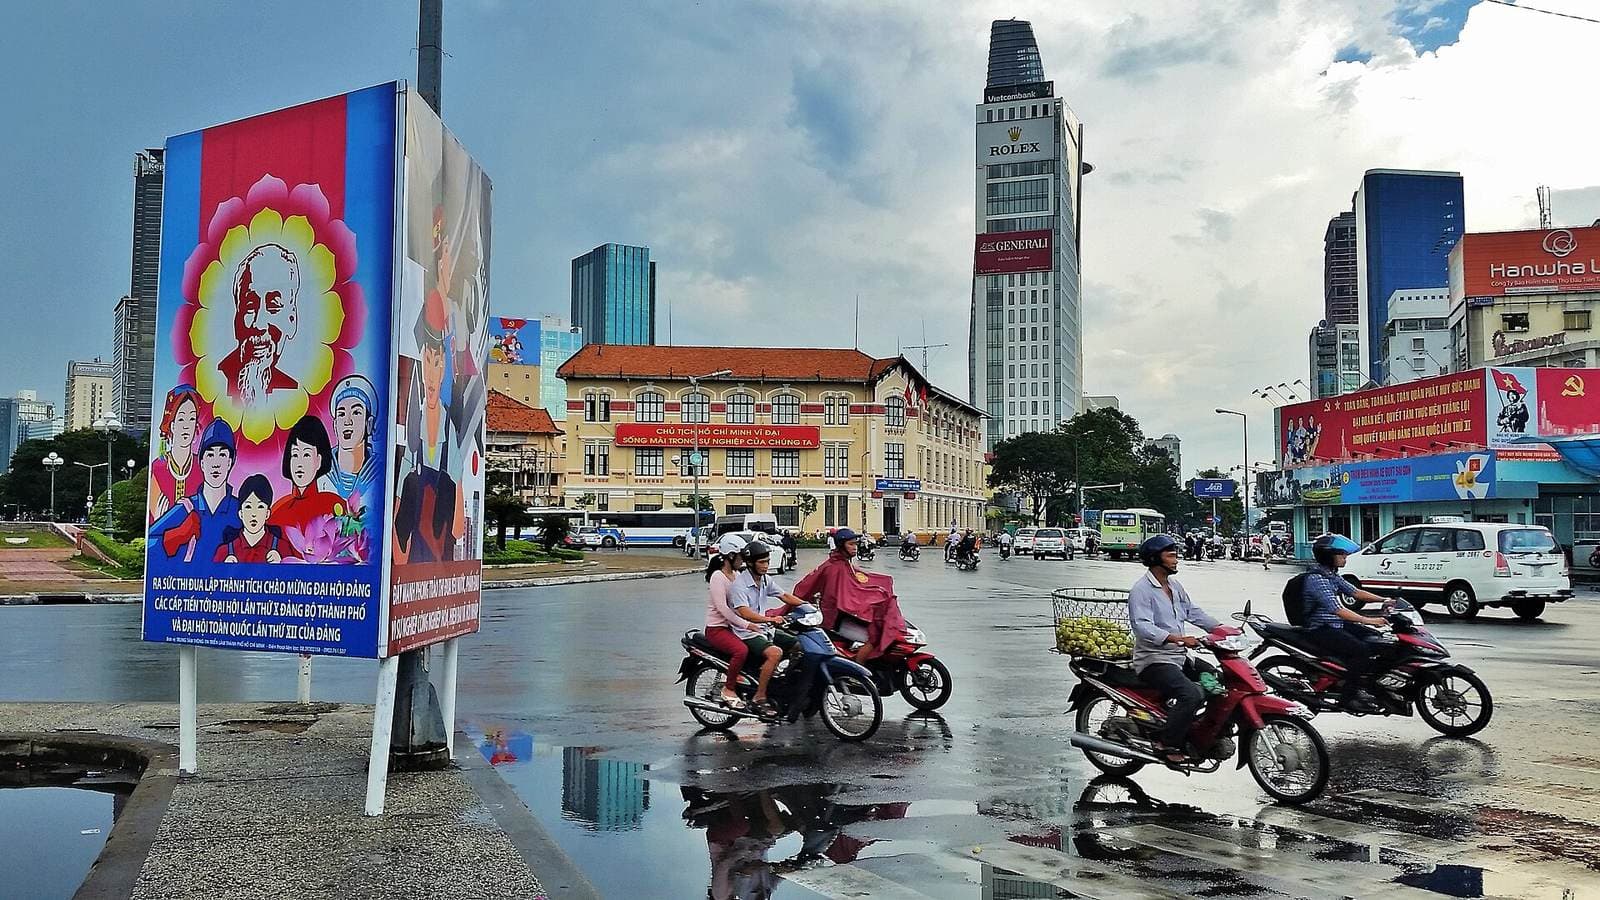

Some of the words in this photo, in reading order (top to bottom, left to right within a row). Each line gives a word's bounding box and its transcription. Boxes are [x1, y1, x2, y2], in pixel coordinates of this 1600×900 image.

[988, 91, 1036, 102] Vietcombank
[989, 142, 1041, 156] ROLEX
[996, 238, 1048, 251] GENERALI
[1490, 260, 1585, 278] Hanwha
[1425, 384, 1438, 398] PHÁT
[1386, 408, 1401, 424] QUYẾT
[656, 426, 675, 435] CHỦ
[677, 427, 695, 436] TỊCH
[765, 429, 780, 437] ĐẠI
[622, 435, 648, 444] SỐNG
[669, 437, 695, 445] TRONG
[699, 437, 711, 445] SỰ
[712, 437, 745, 445] NGHIỆP
[746, 437, 767, 445] CỦA
[768, 438, 800, 446] CHÚNG
[153, 577, 163, 590] RA
[163, 575, 177, 591] SỨC
[177, 578, 188, 591] THI
[189, 578, 204, 591] ĐUA
[205, 576, 219, 594] LẬP
[219, 576, 245, 593] THÀNH
[246, 577, 263, 594] TÍCH
[264, 578, 286, 594] CHÀO
[287, 578, 313, 595] MỪNG
[314, 582, 329, 600] ĐẠI
[329, 580, 345, 600] HỘI
[346, 579, 371, 597] ĐẢNG
[154, 595, 169, 610] CÁC
[169, 594, 183, 612] CẤP,
[183, 594, 198, 612] TIẾN
[199, 597, 212, 613] TỚI
[212, 599, 226, 617] ĐẠI
[227, 598, 240, 617] HỘI
[256, 599, 273, 616] THỨ
[273, 602, 280, 616] X
[280, 600, 304, 618] ĐẢNG
[304, 601, 317, 621] BỘ
[317, 602, 347, 620] THÀNH
[347, 602, 367, 621] PHỐ
[172, 616, 182, 632] VÀ
[182, 619, 195, 636] ĐẠI
[195, 618, 208, 637] HỘI
[209, 618, 229, 635] TOÀN
[230, 618, 252, 637] QUỐC
[269, 622, 286, 639] THỨ
[286, 624, 298, 639] XII
[298, 622, 315, 641] CỦA
[316, 623, 341, 642] ĐẢNG
